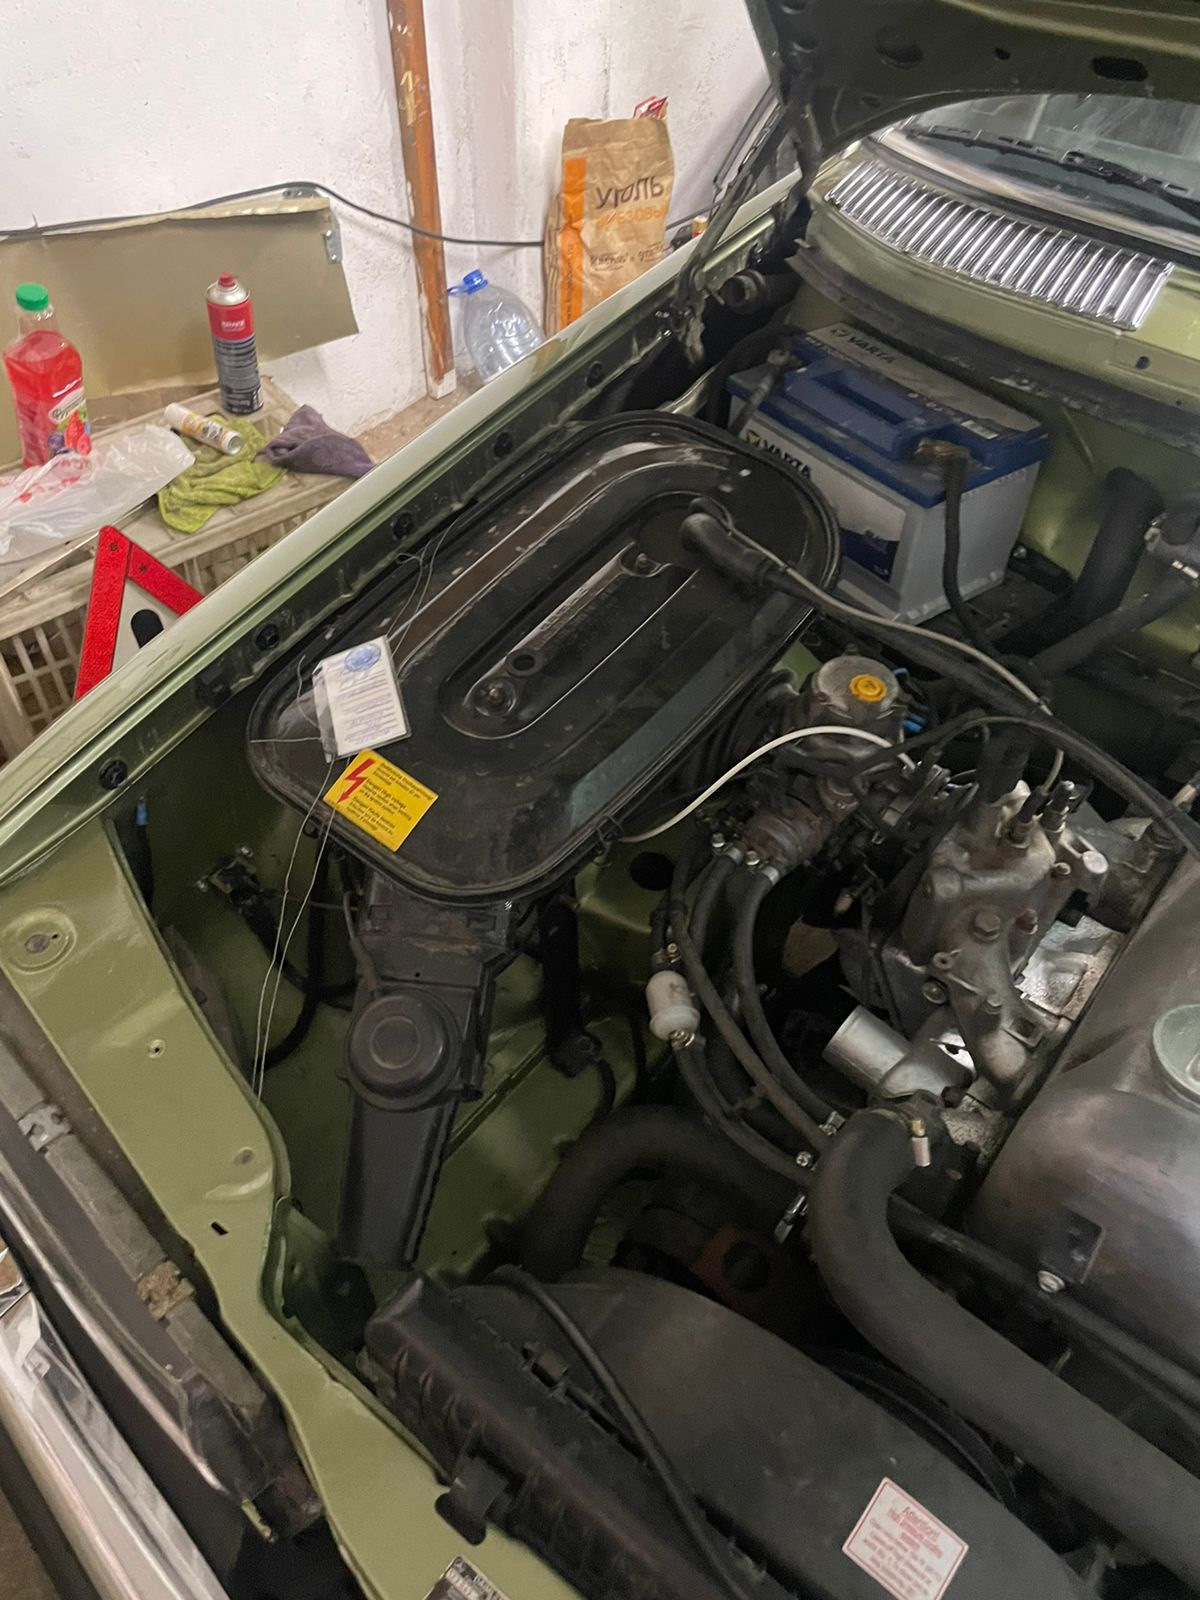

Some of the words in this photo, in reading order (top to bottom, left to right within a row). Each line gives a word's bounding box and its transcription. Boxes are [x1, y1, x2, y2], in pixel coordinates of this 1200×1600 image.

[595, 175, 664, 209] УГОЛЬ
[848, 336, 896, 364] VARTA
[763, 439, 811, 479] VARTA
